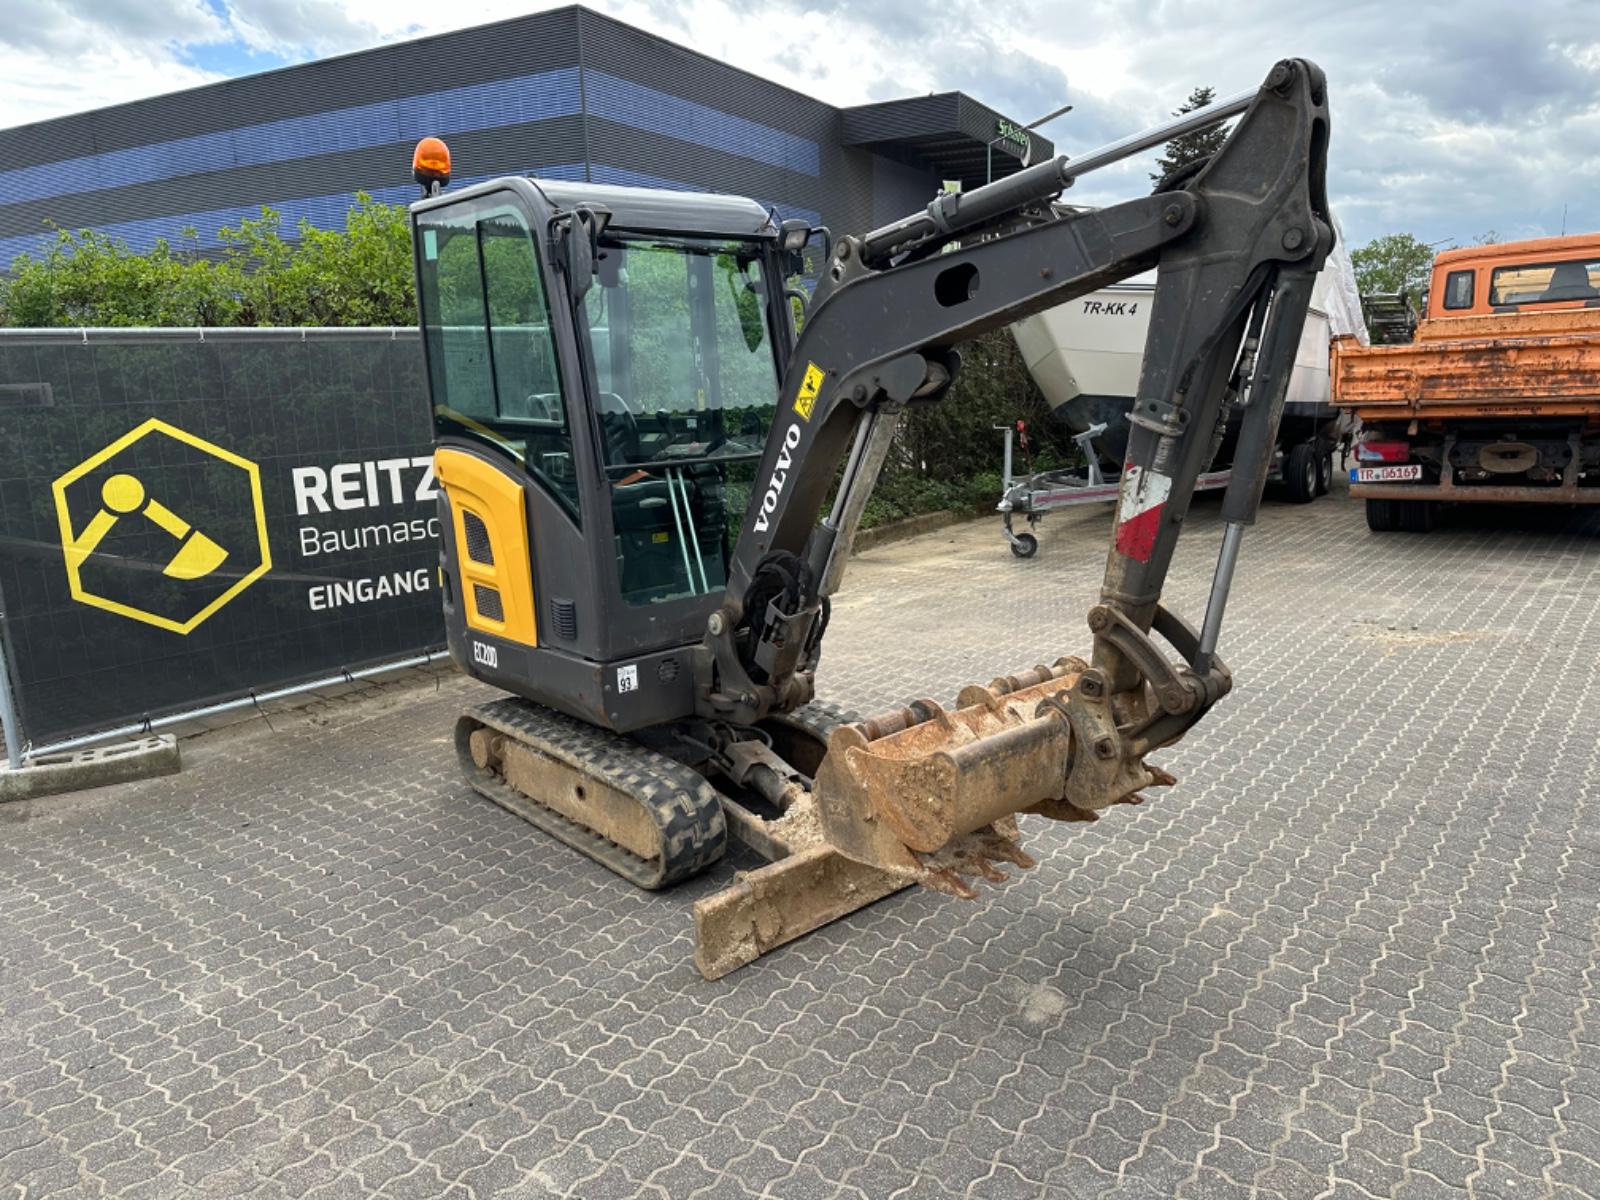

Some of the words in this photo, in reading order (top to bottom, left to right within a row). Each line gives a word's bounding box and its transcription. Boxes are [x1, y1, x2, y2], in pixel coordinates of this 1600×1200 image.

[1083, 301, 1127, 315] TR-KK
[1128, 302, 1138, 316] 4
[291, 455, 438, 516] REITZ
[753, 423, 801, 533] VOLVO
[1359, 468, 1374, 480] TR
[308, 568, 430, 611] EINGANG
[473, 640, 498, 669] EC20D
[620, 677, 631, 691] 93
